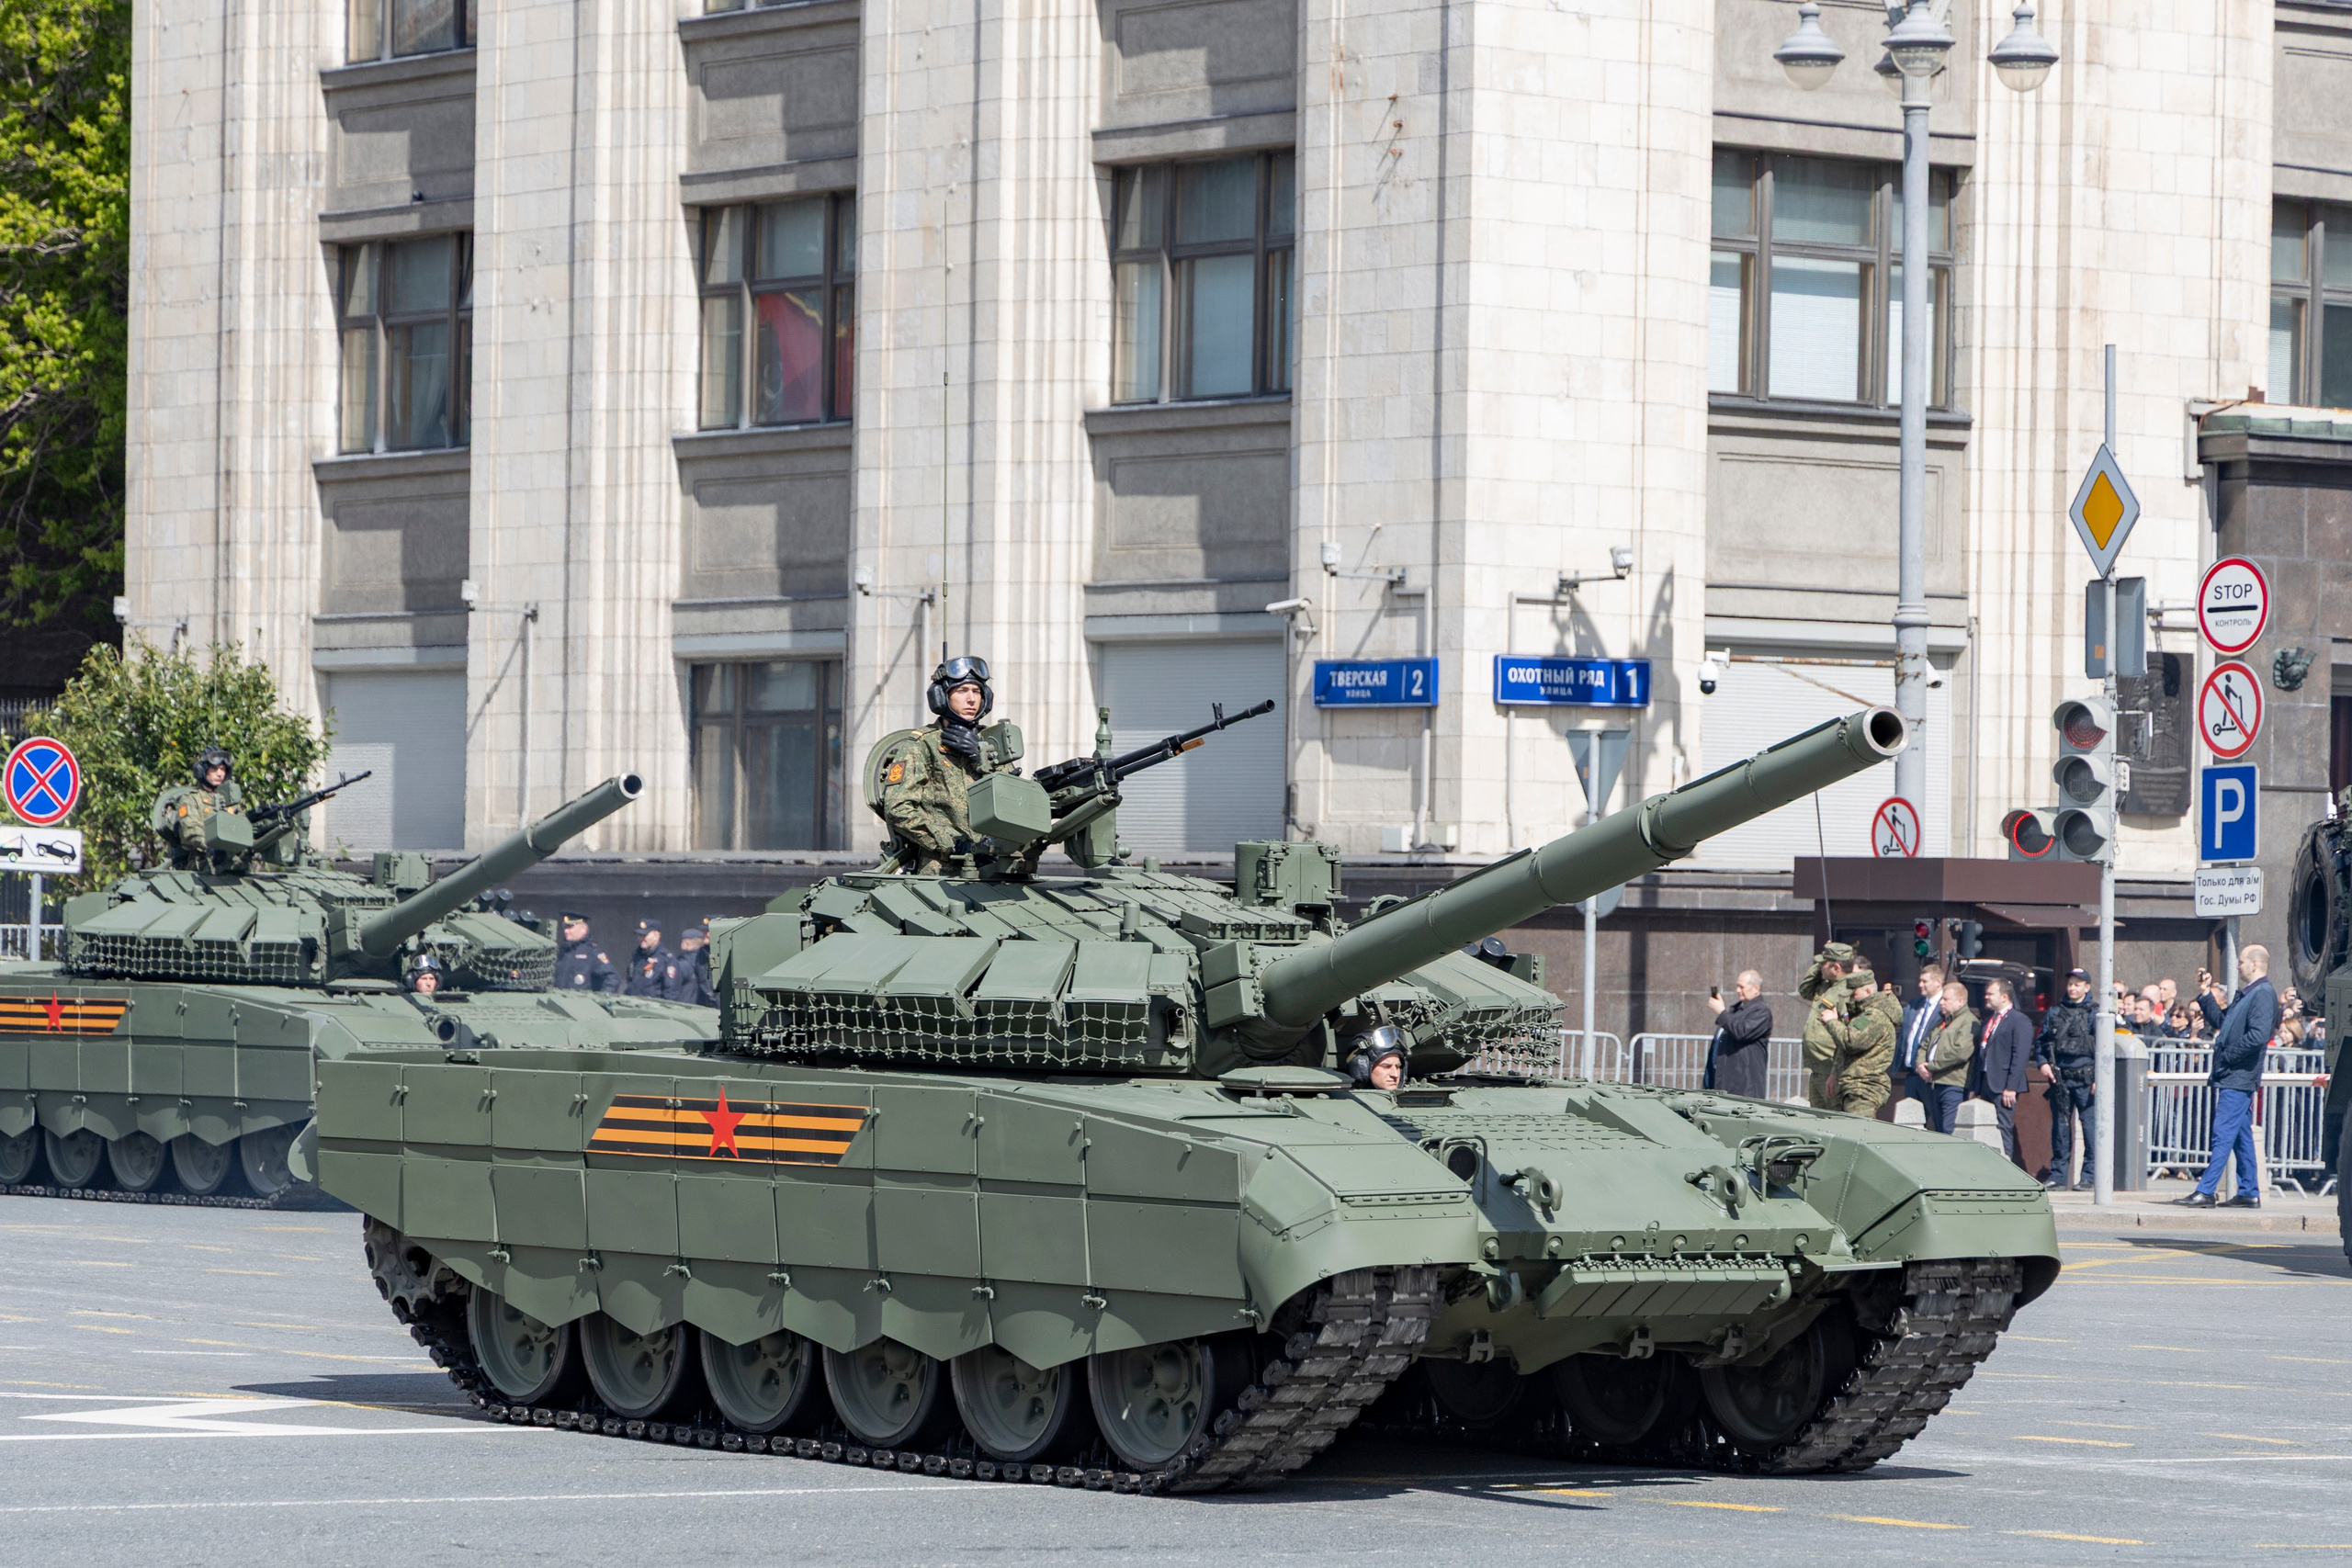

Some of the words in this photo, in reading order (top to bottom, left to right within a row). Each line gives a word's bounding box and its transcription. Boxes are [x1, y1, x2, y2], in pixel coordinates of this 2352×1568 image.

[2214, 583, 2253, 600] STOP
[2215, 618, 2252, 627] КОНТРОЛЬ
[1329, 670, 1388, 687] ТВЕРСКАЯ
[1411, 669, 1424, 696] 2
[1508, 667, 1575, 685] ОХОТНЫЙ
[1578, 669, 1605, 687] РЯД
[1626, 667, 1638, 698] 1
[1540, 685, 1573, 696] УЛИЦА
[2214, 778, 2245, 849] P
[2197, 876, 2226, 886] Только
[2228, 876, 2245, 887] для
[2246, 874, 2259, 885] а/м
[2199, 895, 2216, 906] Гос.
[2218, 894, 2242, 907] Думы
[2244, 893, 2256, 903] РФ
